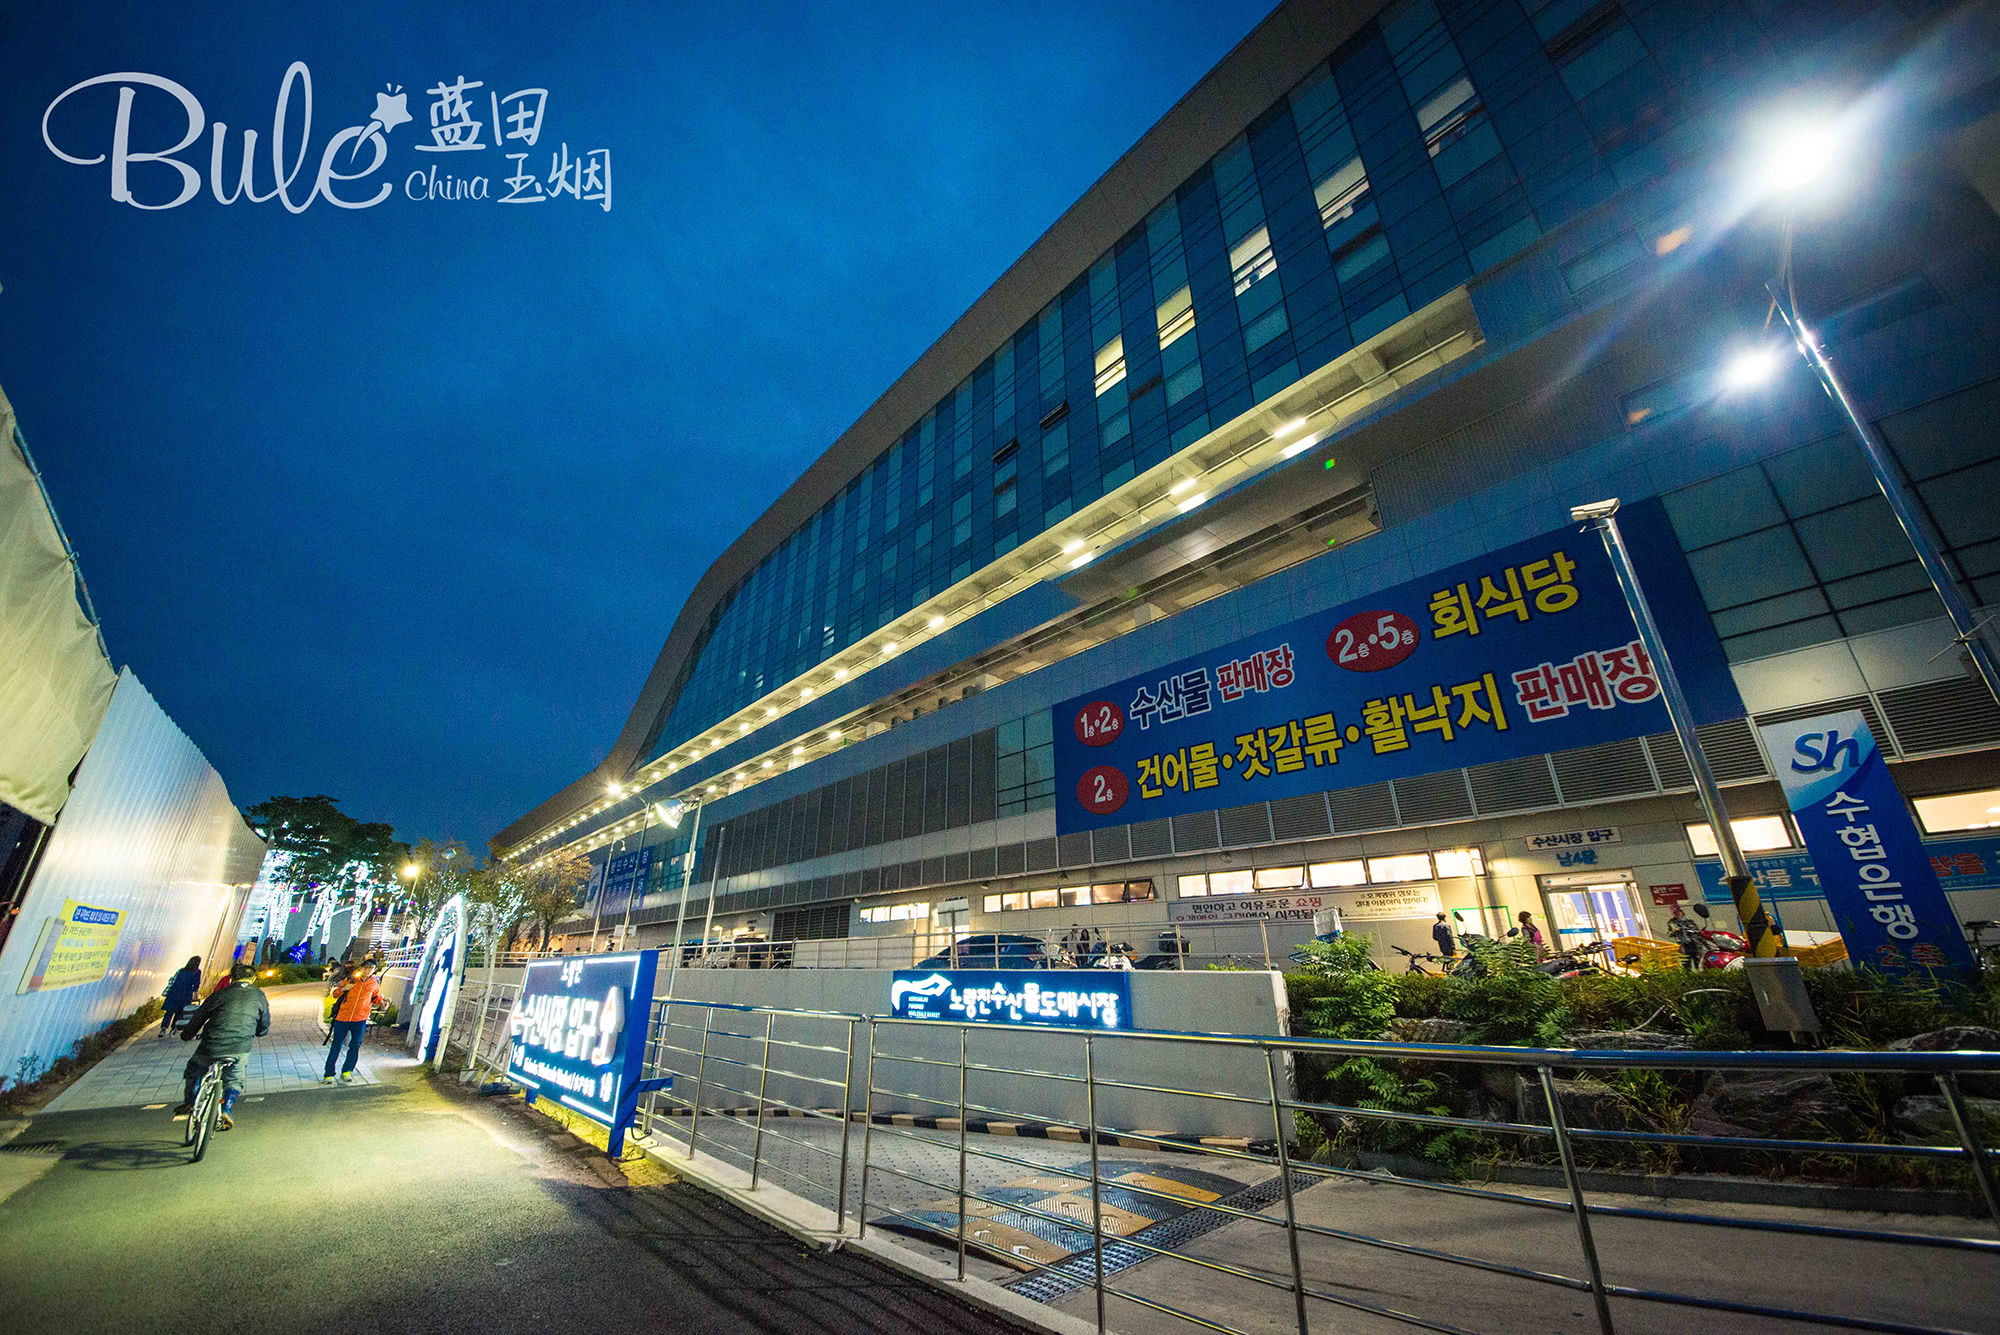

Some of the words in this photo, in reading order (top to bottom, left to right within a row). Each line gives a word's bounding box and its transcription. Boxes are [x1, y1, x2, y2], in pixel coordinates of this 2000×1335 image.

[1428, 551, 1580, 640] 회식당
[1130, 667, 1212, 731] 수산물
[1216, 643, 1295, 703] 판매장
[1094, 774, 1113, 803] 2층
[1511, 639, 1661, 722] 판매장
[1791, 729, 1862, 772] Sh
[1532, 832, 1583, 847] 수산시장
[1587, 828, 1614, 842] 입구
[1825, 791, 1919, 940] 수협은행
[1241, 898, 1290, 911] 여유로운
[949, 981, 1120, 1028] 노량진수산물도매시장
